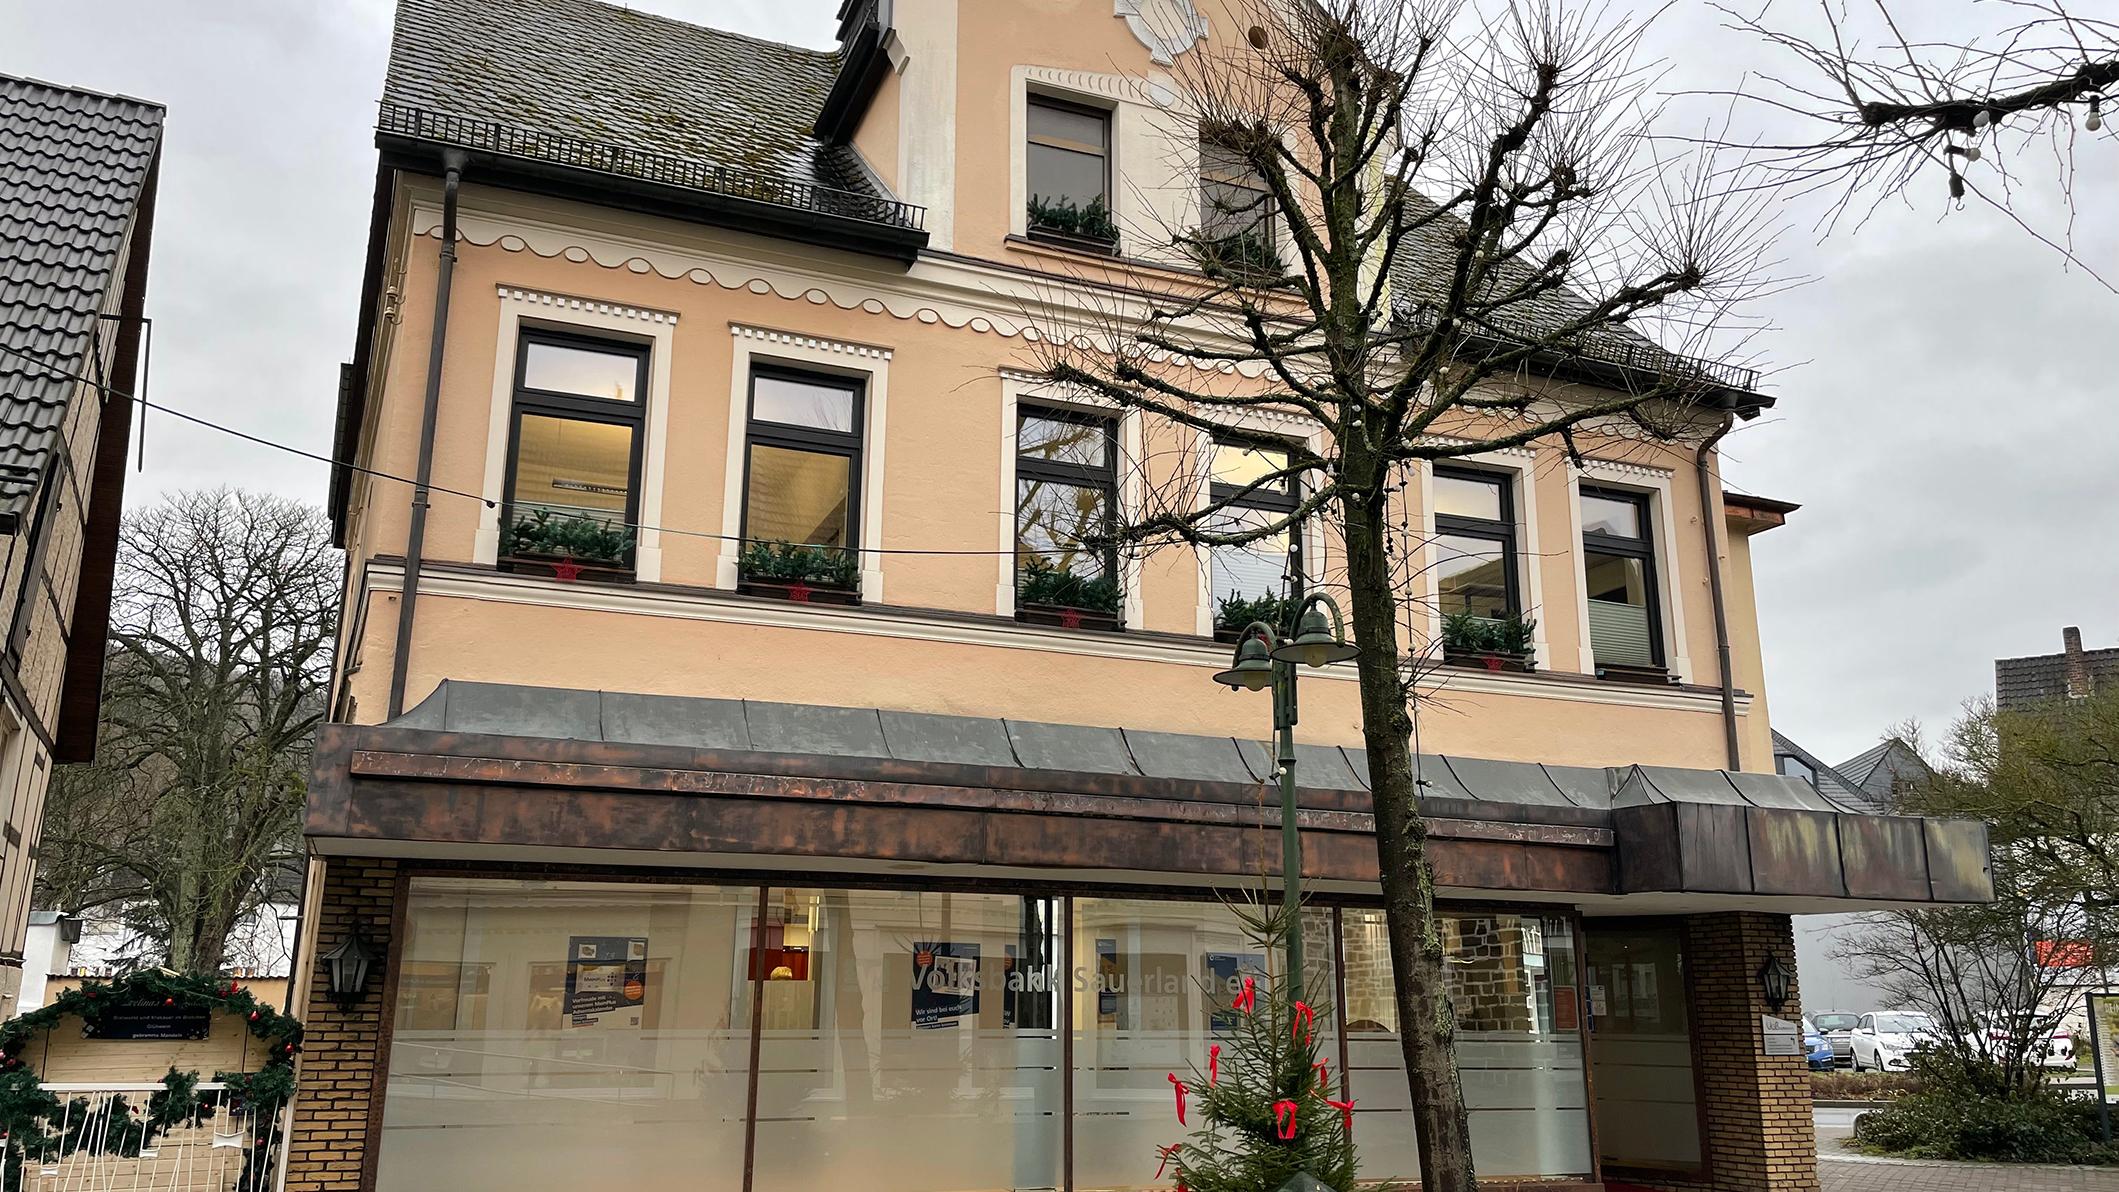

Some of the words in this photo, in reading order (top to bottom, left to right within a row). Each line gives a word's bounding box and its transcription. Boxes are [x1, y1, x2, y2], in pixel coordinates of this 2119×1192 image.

[1073, 966, 1216, 995] Sauerland
[915, 1007, 926, 1016] Wir
[926, 1005, 938, 1014] sind
